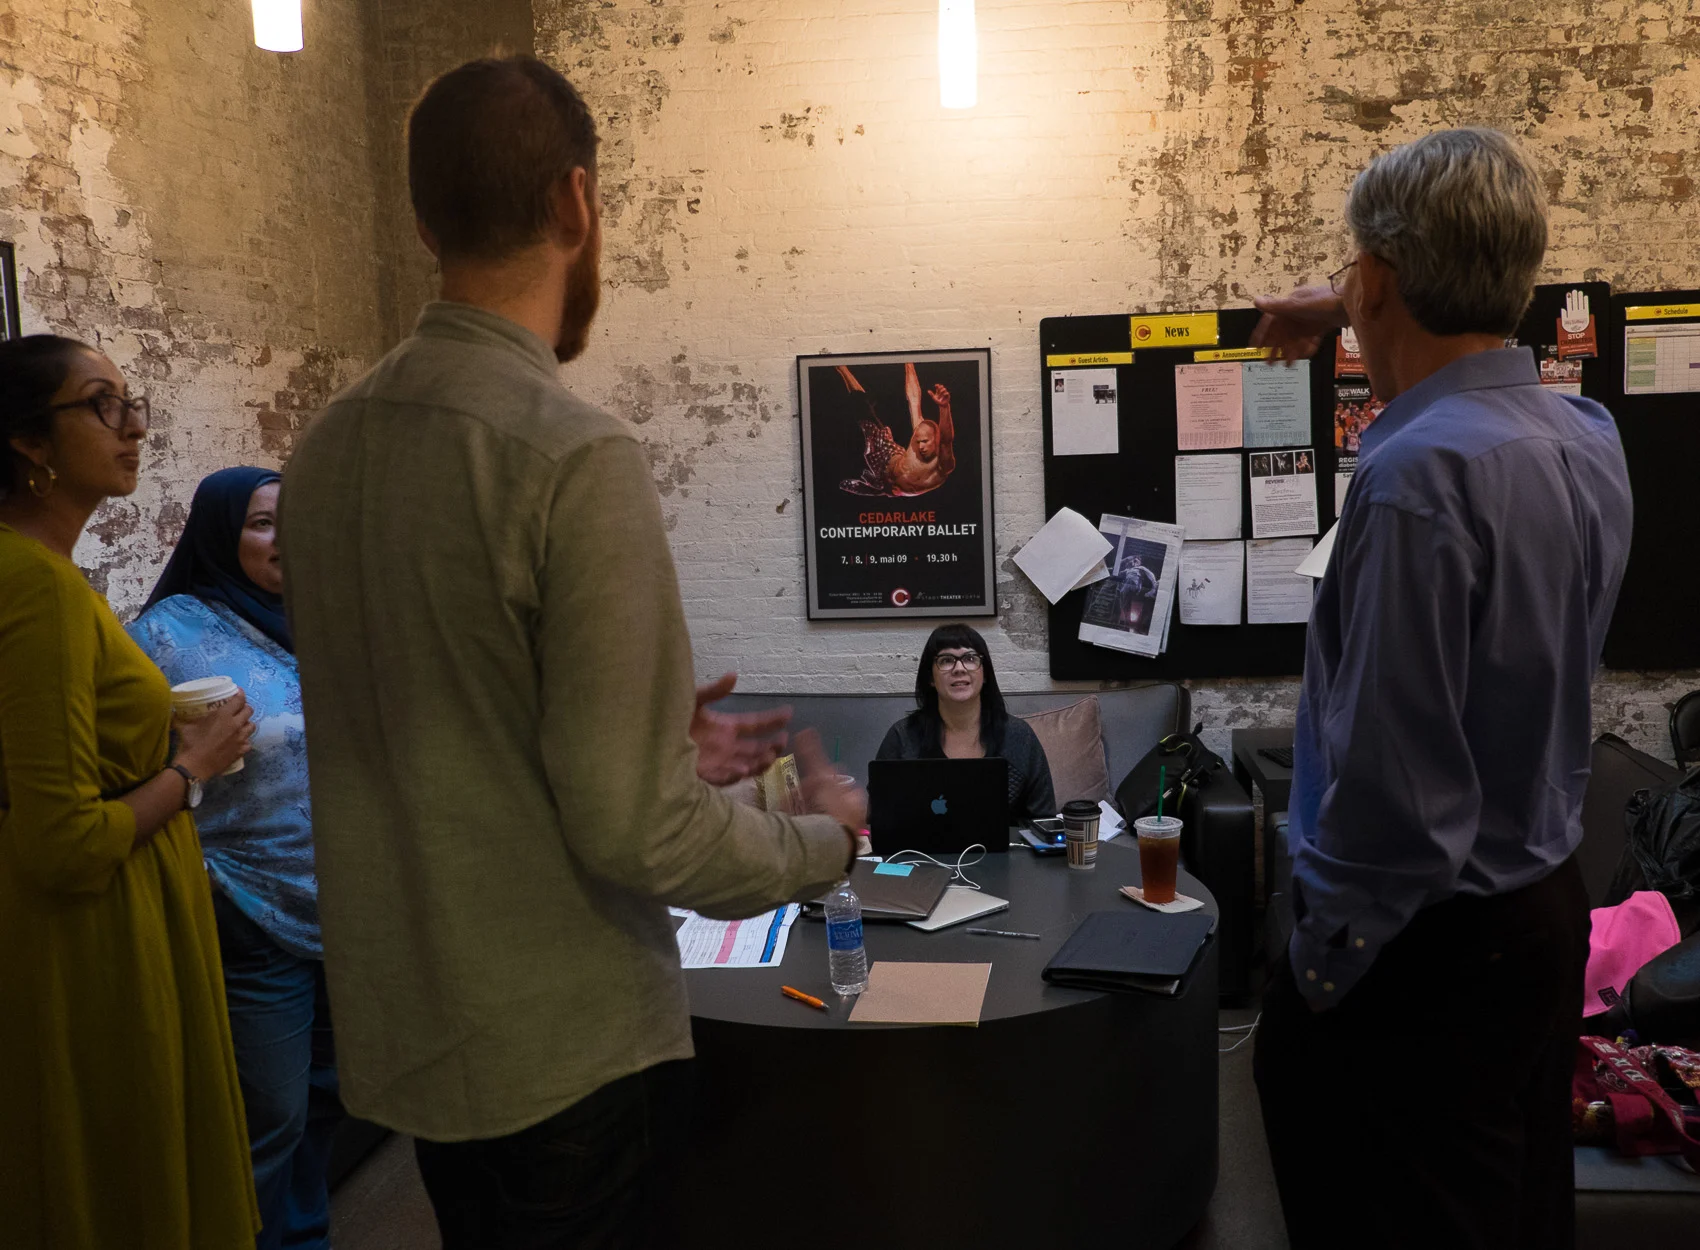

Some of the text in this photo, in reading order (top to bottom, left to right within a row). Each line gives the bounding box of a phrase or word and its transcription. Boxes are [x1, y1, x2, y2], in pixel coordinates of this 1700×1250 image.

[1164, 326, 1190, 338] News
[1093, 355, 1109, 363] Artists
[1222, 349, 1262, 359] Announcements
[1350, 387, 1370, 395] WALK
[859, 511, 936, 524] CEDARLAKE
[820, 524, 977, 539] CONTEMPORARY BALLET
[841, 553, 957, 565] 7. 8. 9. mai 09 19.30 h
